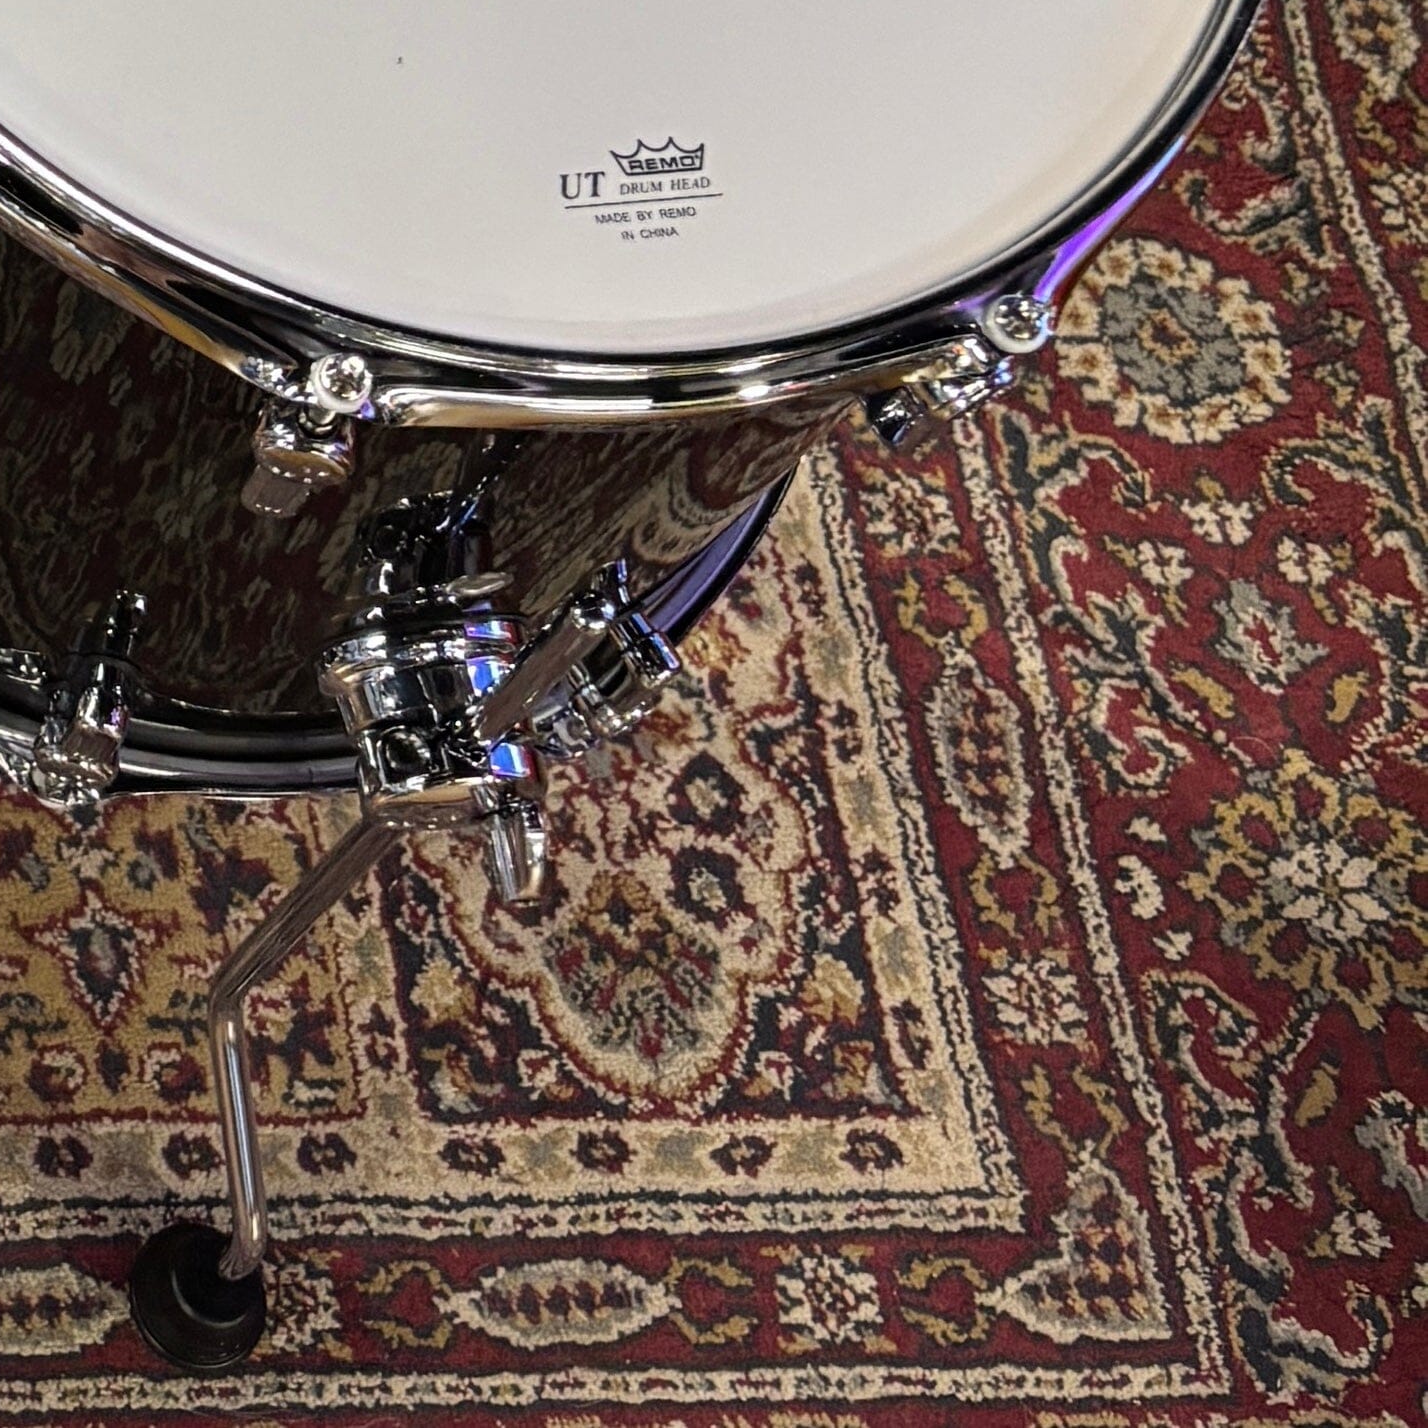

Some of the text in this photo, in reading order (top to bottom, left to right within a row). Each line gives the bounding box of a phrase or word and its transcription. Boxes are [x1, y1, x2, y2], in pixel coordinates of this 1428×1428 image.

[628, 155, 695, 171] REMO
[560, 171, 710, 199] UT DRUM HEAD
[595, 207, 696, 224] MADE BY REMO
[621, 227, 678, 240] IN CHINA
